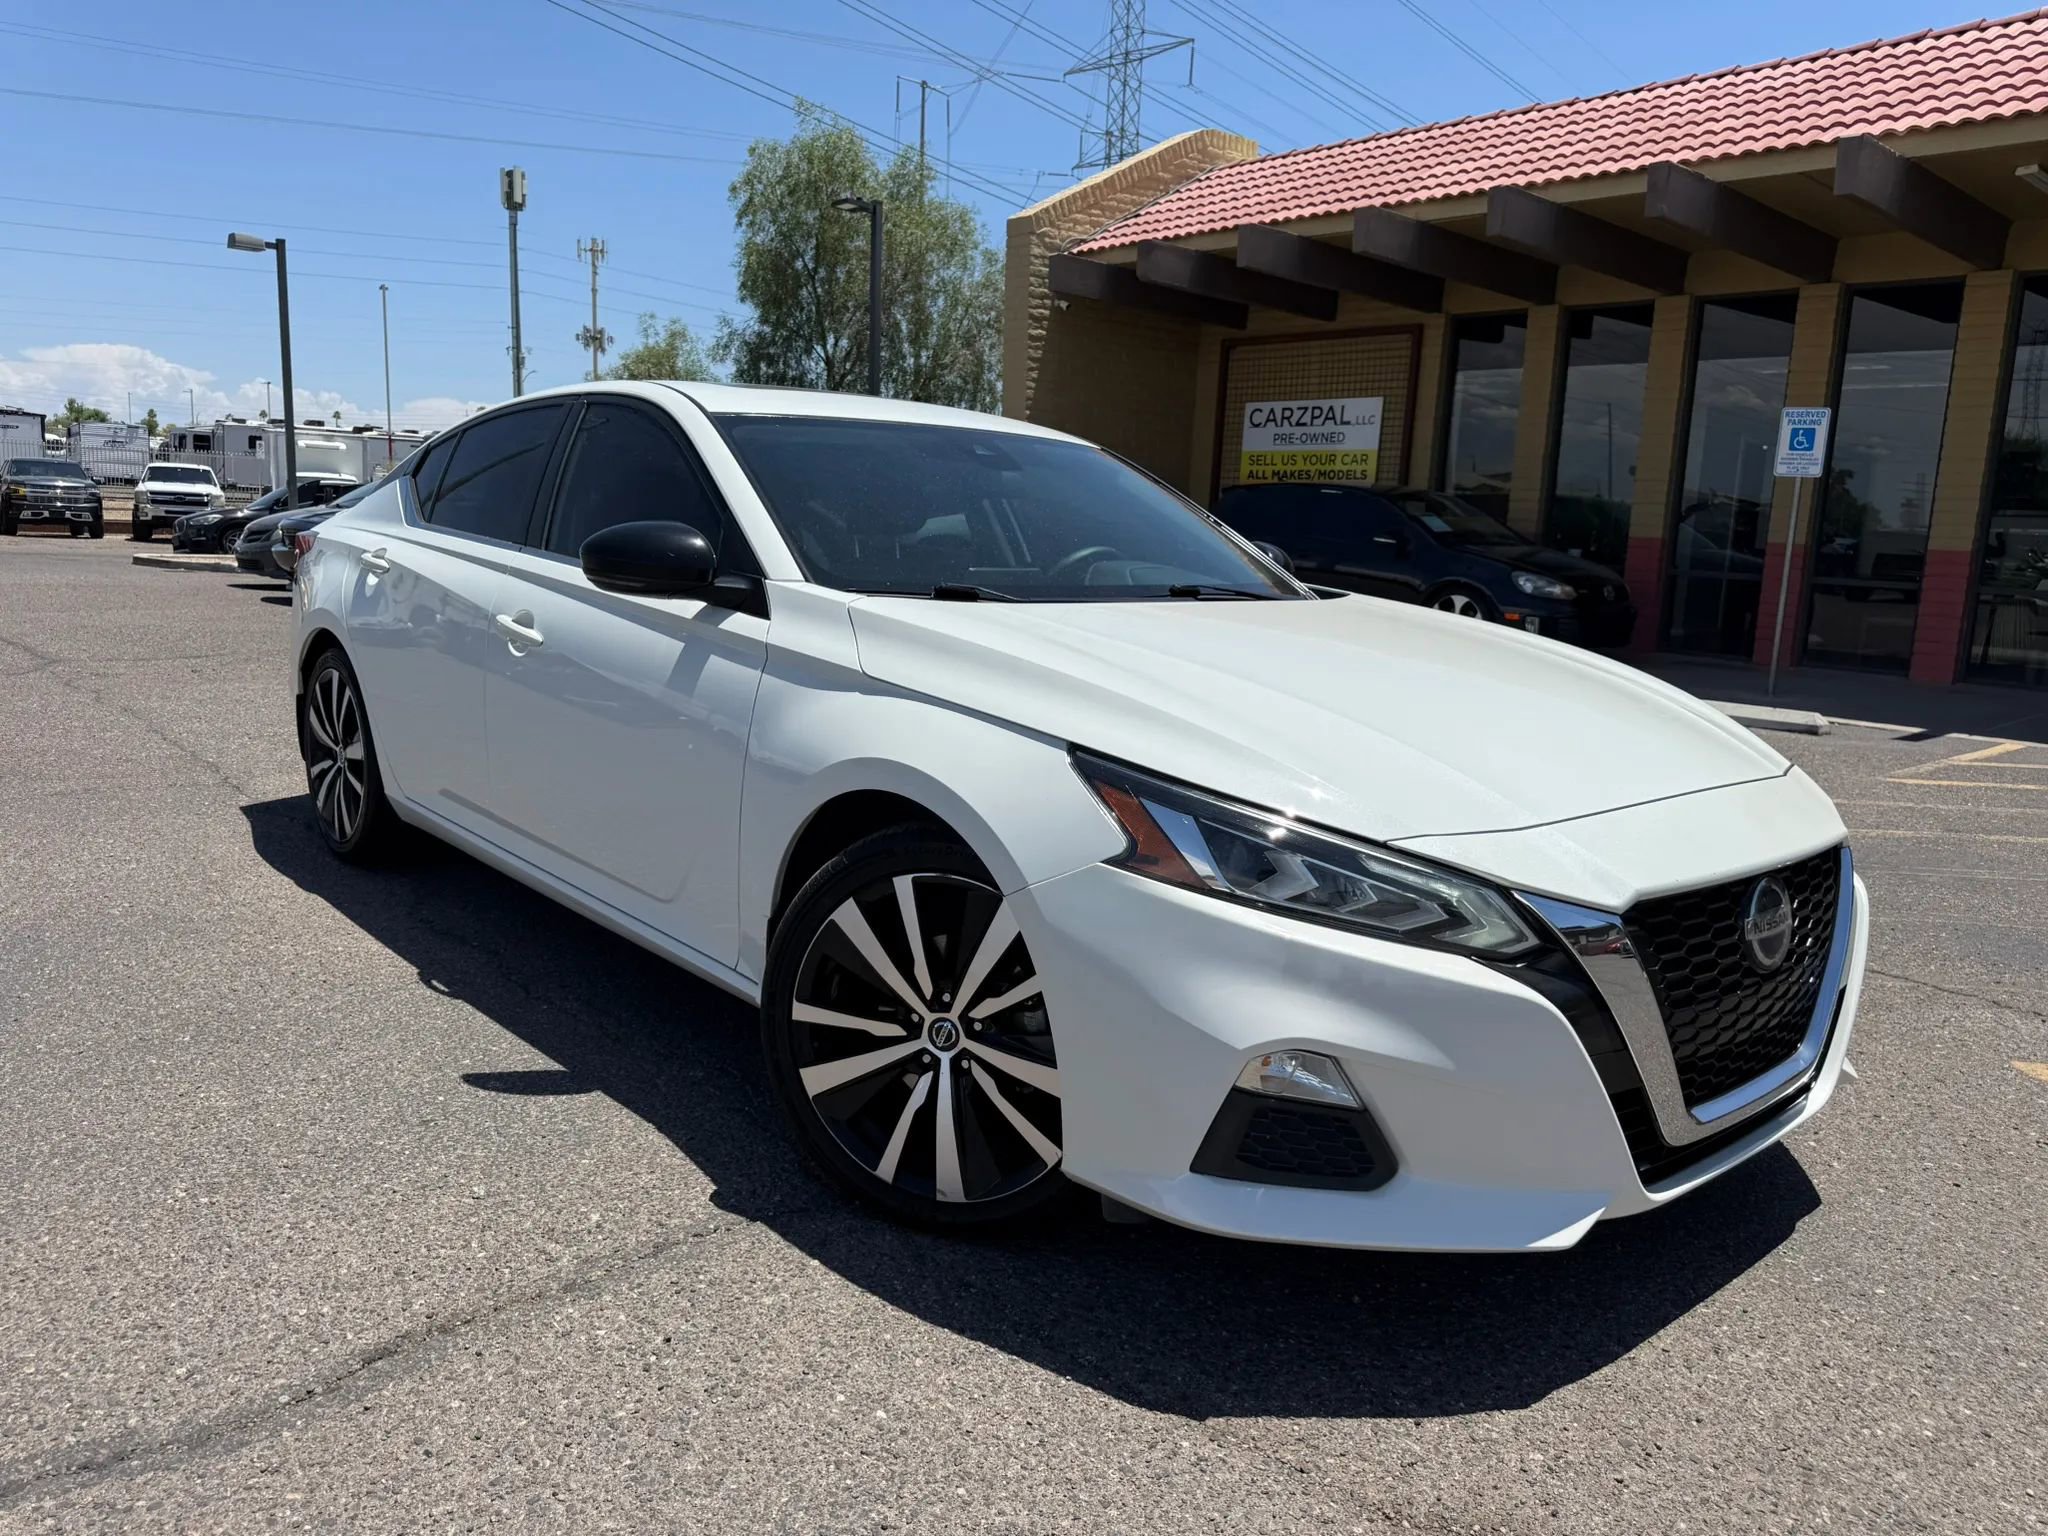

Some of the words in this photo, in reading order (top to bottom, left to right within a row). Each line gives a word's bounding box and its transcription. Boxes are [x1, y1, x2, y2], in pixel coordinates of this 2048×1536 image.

[1356, 414, 1376, 426] LLC
[1785, 410, 1826, 418] RESERVED
[1787, 418, 1822, 426] PARKING
[1273, 432, 1346, 444] PRE-OWNED
[1248, 454, 1277, 466] SELL
[1281, 453, 1297, 466] US
[1302, 453, 1337, 466] YOUR
[1341, 453, 1369, 466] CAR
[1247, 470, 1268, 481] ALL
[1271, 468, 1368, 482] MAKES/MODELS
[1754, 911, 1788, 934] NISSAN
